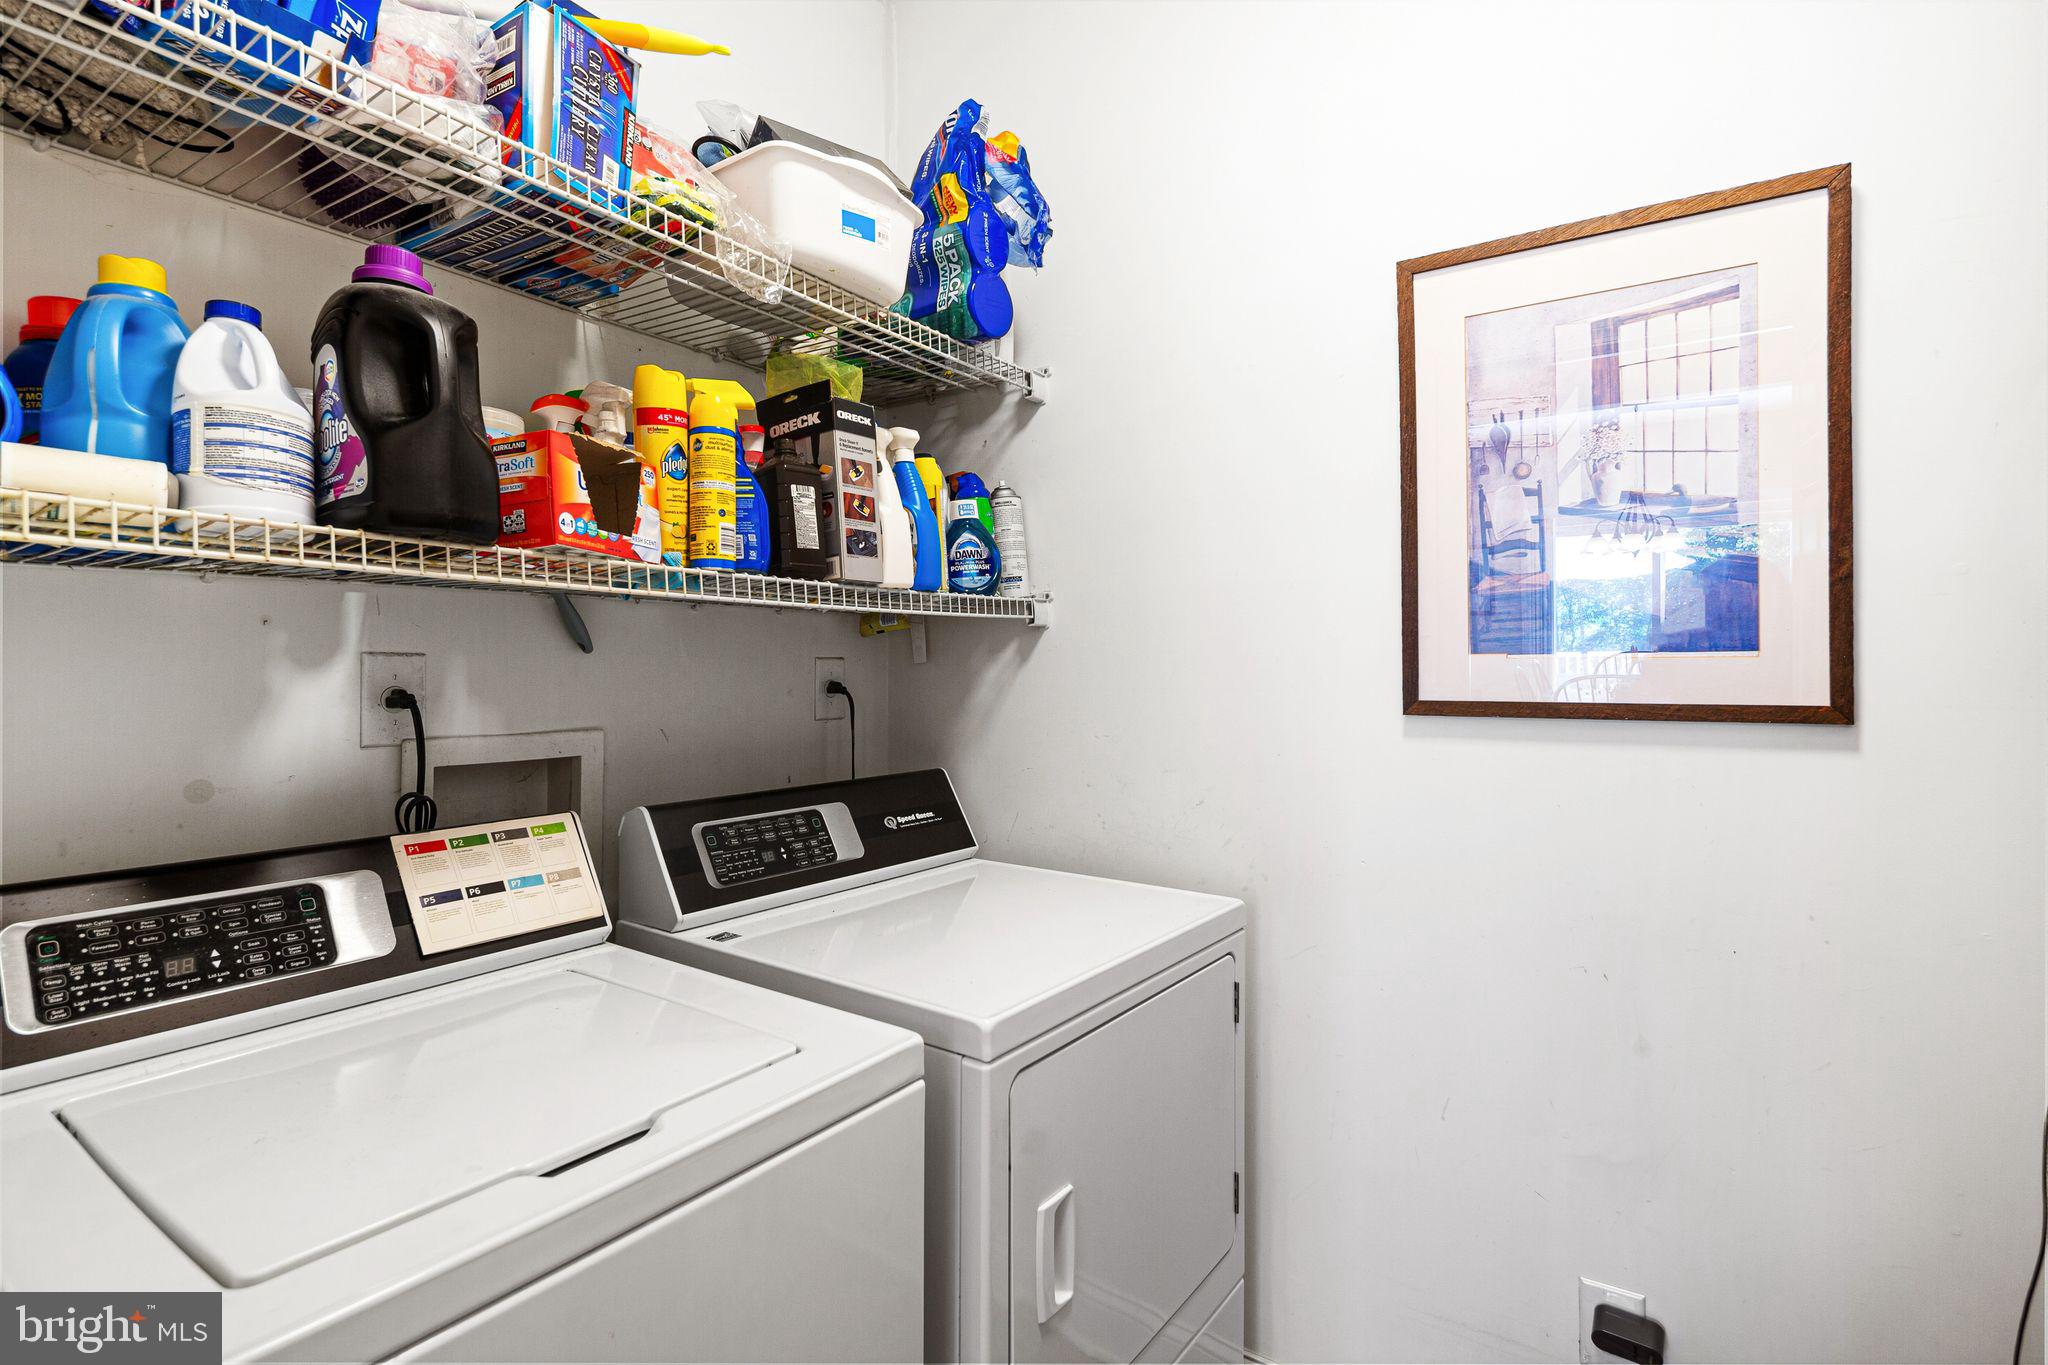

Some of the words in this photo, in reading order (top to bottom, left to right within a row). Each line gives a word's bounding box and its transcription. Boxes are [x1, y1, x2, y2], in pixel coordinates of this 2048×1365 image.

[605, 73, 618, 95] 360
[625, 112, 636, 166] KIRKLAND
[585, 124, 600, 174] CLEAR
[943, 234, 954, 247] 5
[934, 241, 945, 263] 425
[945, 249, 961, 307] PACK
[938, 263, 949, 308] WIPES
[657, 413, 673, 422] 45%
[836, 409, 872, 427] ORECK
[769, 411, 821, 438] ORECK
[492, 441, 526, 452] KIRKLAND
[662, 456, 687, 478] pledg
[644, 469, 655, 479] 250
[560, 518, 566, 526] 4
[644, 539, 656, 547] SCENT
[955, 549, 983, 560] DAWN
[951, 563, 990, 572] POWERWASH
[897, 814, 916, 823] Speed
[533, 826, 544, 835] P4
[494, 832, 506, 841] P3
[452, 838, 465, 847] P2
[408, 845, 420, 854] P1
[548, 873, 560, 881] P8
[510, 879, 521, 888] P7
[468, 887, 481, 896] P6
[423, 896, 436, 905] P5
[142, 935, 159, 943] Bulky
[91, 943, 119, 951] Favorites
[218, 970, 231, 978] Lock
[90, 979, 115, 988] Medium
[117, 975, 134, 983] Large
[166, 978, 188, 988] Control
[73, 999, 90, 1008] Light
[118, 990, 137, 998] Heavy
